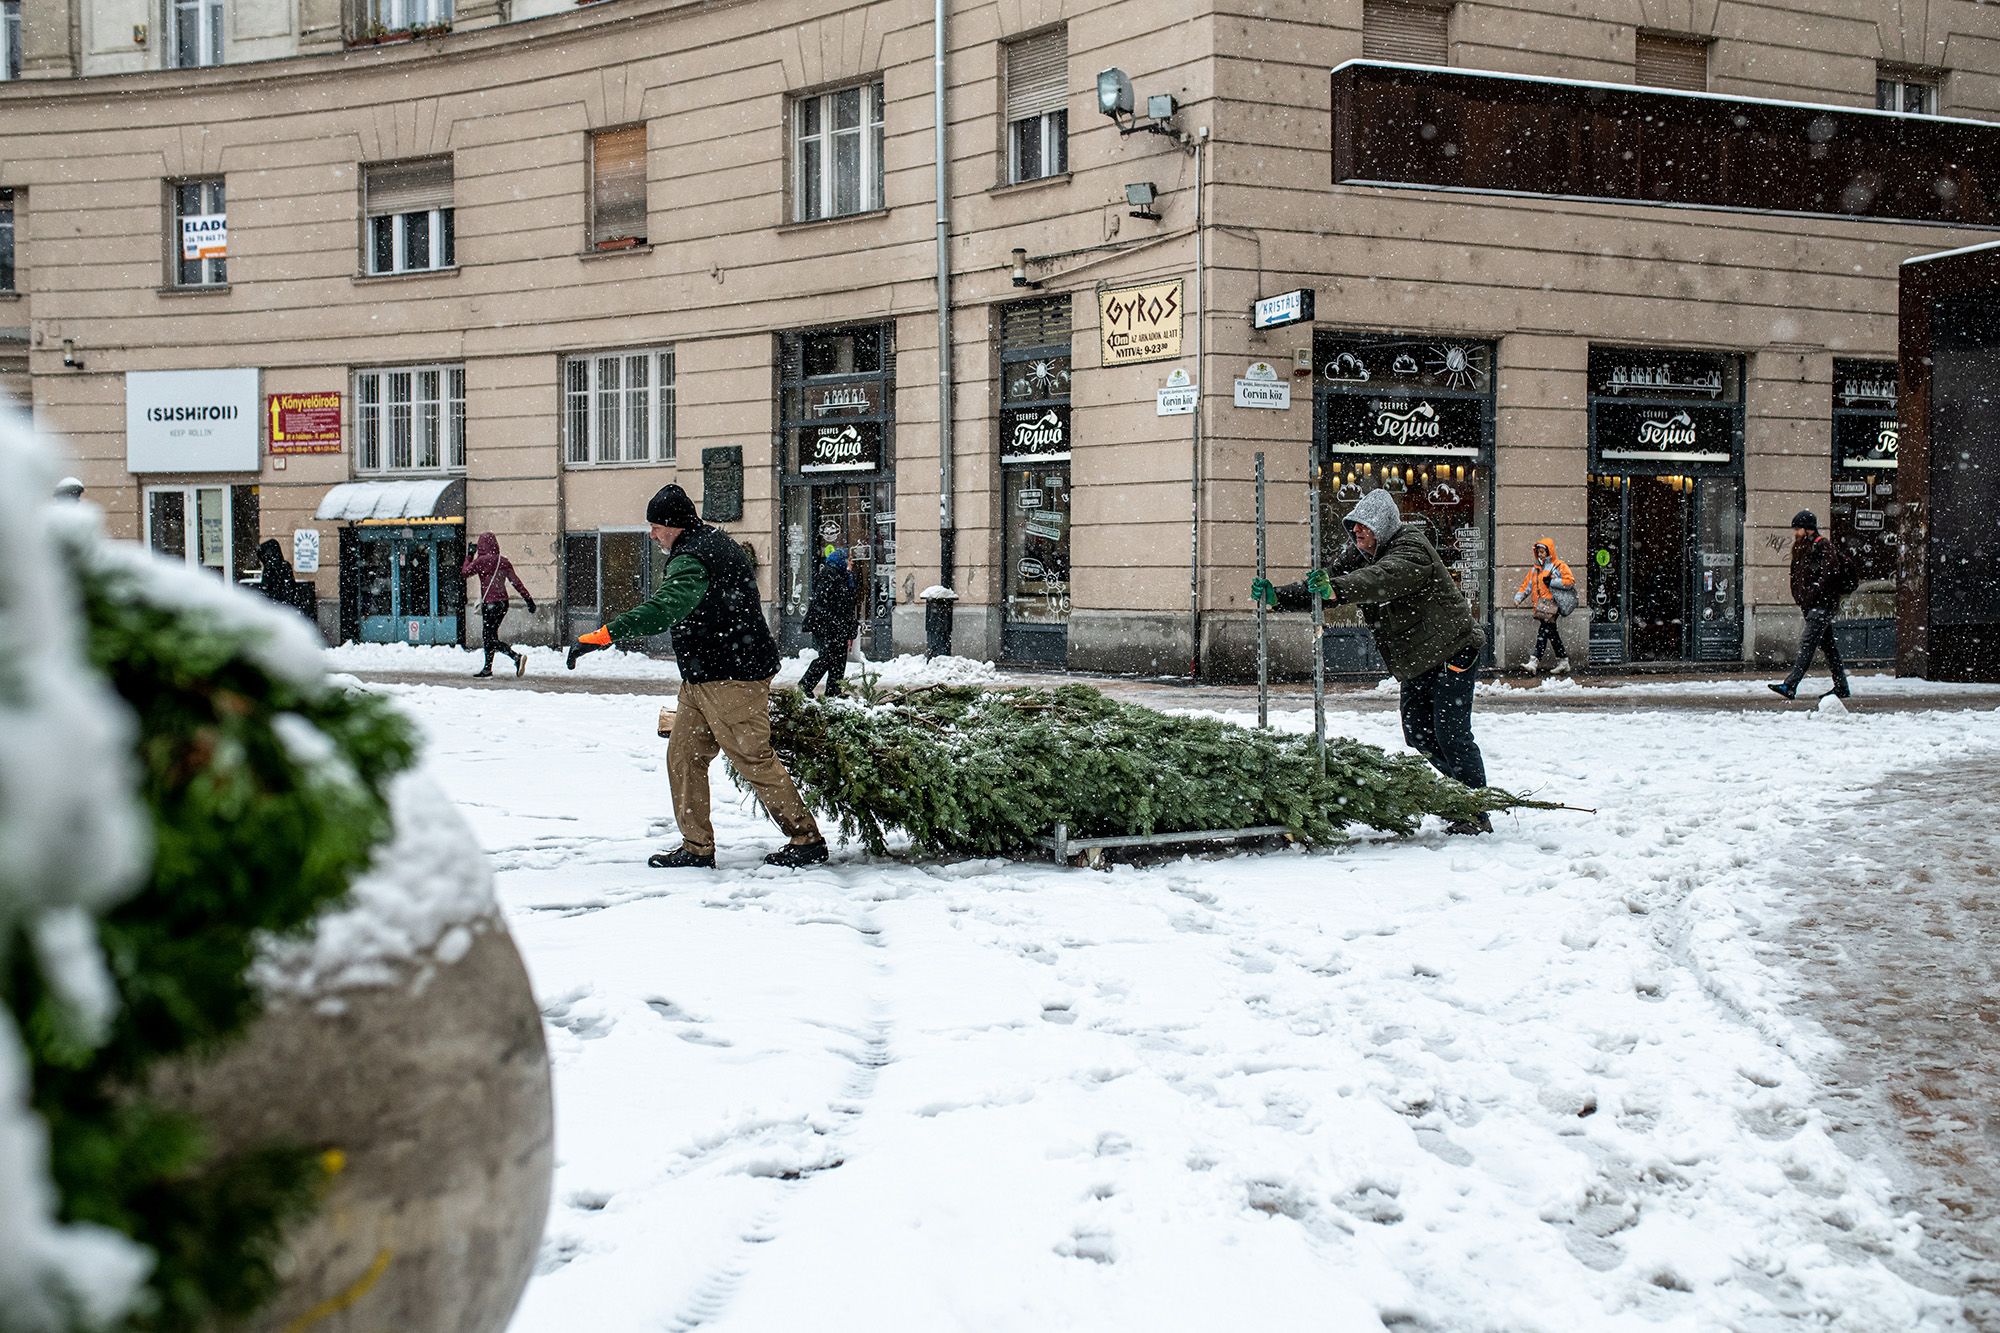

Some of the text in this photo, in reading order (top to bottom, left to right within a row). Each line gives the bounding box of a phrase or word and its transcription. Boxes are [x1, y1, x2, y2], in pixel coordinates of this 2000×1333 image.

[1106, 286, 1178, 330] GYROS
[1163, 394, 1193, 407] Corvin köz
[1243, 388, 1283, 400] Corvin köz
[281, 393, 339, 412] Könyvelőiroda
[1380, 401, 1408, 410] CSERPES
[1016, 412, 1038, 421] CSERPES
[170, 429, 185, 437] KEEP
[818, 427, 839, 435] CSERPES
[1012, 421, 1062, 452] Tejivó
[1373, 413, 1440, 445] Tejivó
[1637, 421, 1697, 451] Tejivó
[814, 434, 862, 463] Tejivó
